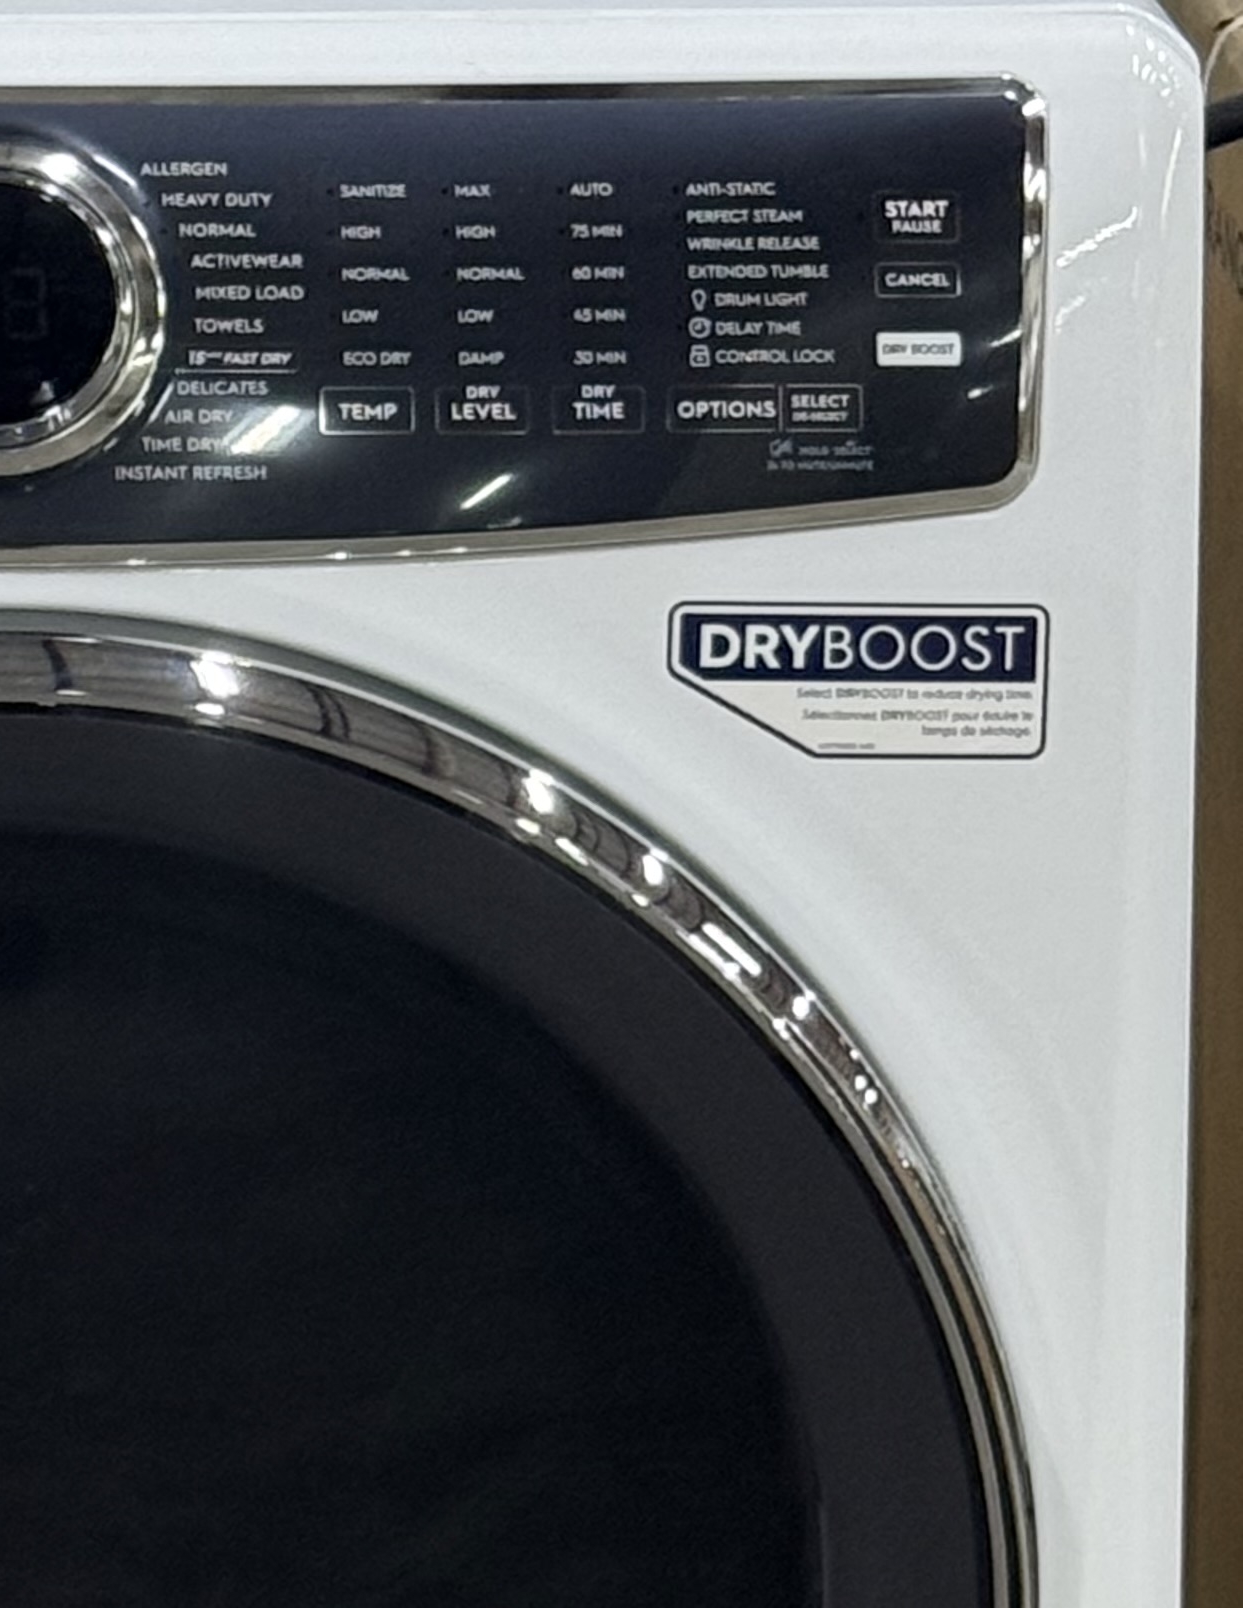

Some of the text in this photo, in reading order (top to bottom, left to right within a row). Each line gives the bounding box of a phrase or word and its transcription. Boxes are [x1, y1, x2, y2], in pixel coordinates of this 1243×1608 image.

[140, 162, 228, 177] ALLERGEN
[339, 183, 407, 199] SANITIZE
[454, 184, 491, 198] MAX
[569, 182, 613, 197] AUTO
[685, 181, 776, 196] ANTI-STATIC
[161, 192, 273, 208] HEAVY DUTY
[686, 209, 803, 223] PERFECT STEAM
[884, 200, 949, 219] START
[178, 223, 257, 238] NORMAL
[340, 225, 381, 239] HIGH
[455, 225, 496, 239] HIGH
[570, 224, 624, 238] 75 MIN
[891, 219, 942, 234] PAUSE
[686, 236, 820, 251] WRINKLE RELEASE
[191, 253, 304, 269] ACTIVEWEAR
[341, 267, 410, 282] NORMAL
[457, 267, 525, 281] NORMAL
[572, 266, 626, 280] 60 MIN
[688, 264, 830, 279] EXTENDED TUMBLE
[885, 272, 950, 288] CANCEL
[196, 285, 305, 301] MIXED LOAD
[714, 291, 809, 307] DRUM LIGHT
[342, 310, 379, 324] LOW
[458, 310, 494, 324] LOW
[595, 309, 627, 323] MIN
[194, 317, 265, 334] TOWELS
[715, 320, 802, 335] DELAY TIME
[715, 349, 837, 365] CONTROL LOCK
[882, 343, 955, 356] DRY BOOST
[222, 351, 259, 366] FAST
[260, 351, 293, 366] DRY
[343, 352, 411, 366] ECO DRY
[458, 351, 505, 366] DAMP
[596, 351, 627, 365] MIN
[176, 381, 269, 397] DELICATES
[465, 385, 501, 399] DRY
[580, 385, 617, 399] DRY
[790, 394, 851, 409] SELECT
[163, 408, 234, 425] AIR DRY
[338, 402, 399, 421] TEMP
[450, 403, 517, 421] LEVEL
[572, 402, 626, 420] TIME
[676, 401, 777, 420] OPTIONS
[141, 435, 225, 452] TIME DRY
[115, 465, 268, 482] INSTANT REFRESH
[700, 622, 1026, 673] DRYBOOST
[797, 688, 833, 699] Select
[836, 687, 905, 700] DRYBOOST
[921, 689, 963, 700] reduce
[965, 688, 1004, 703] drying
[880, 709, 949, 722] DRYBOOST
[951, 712, 980, 724] pour
